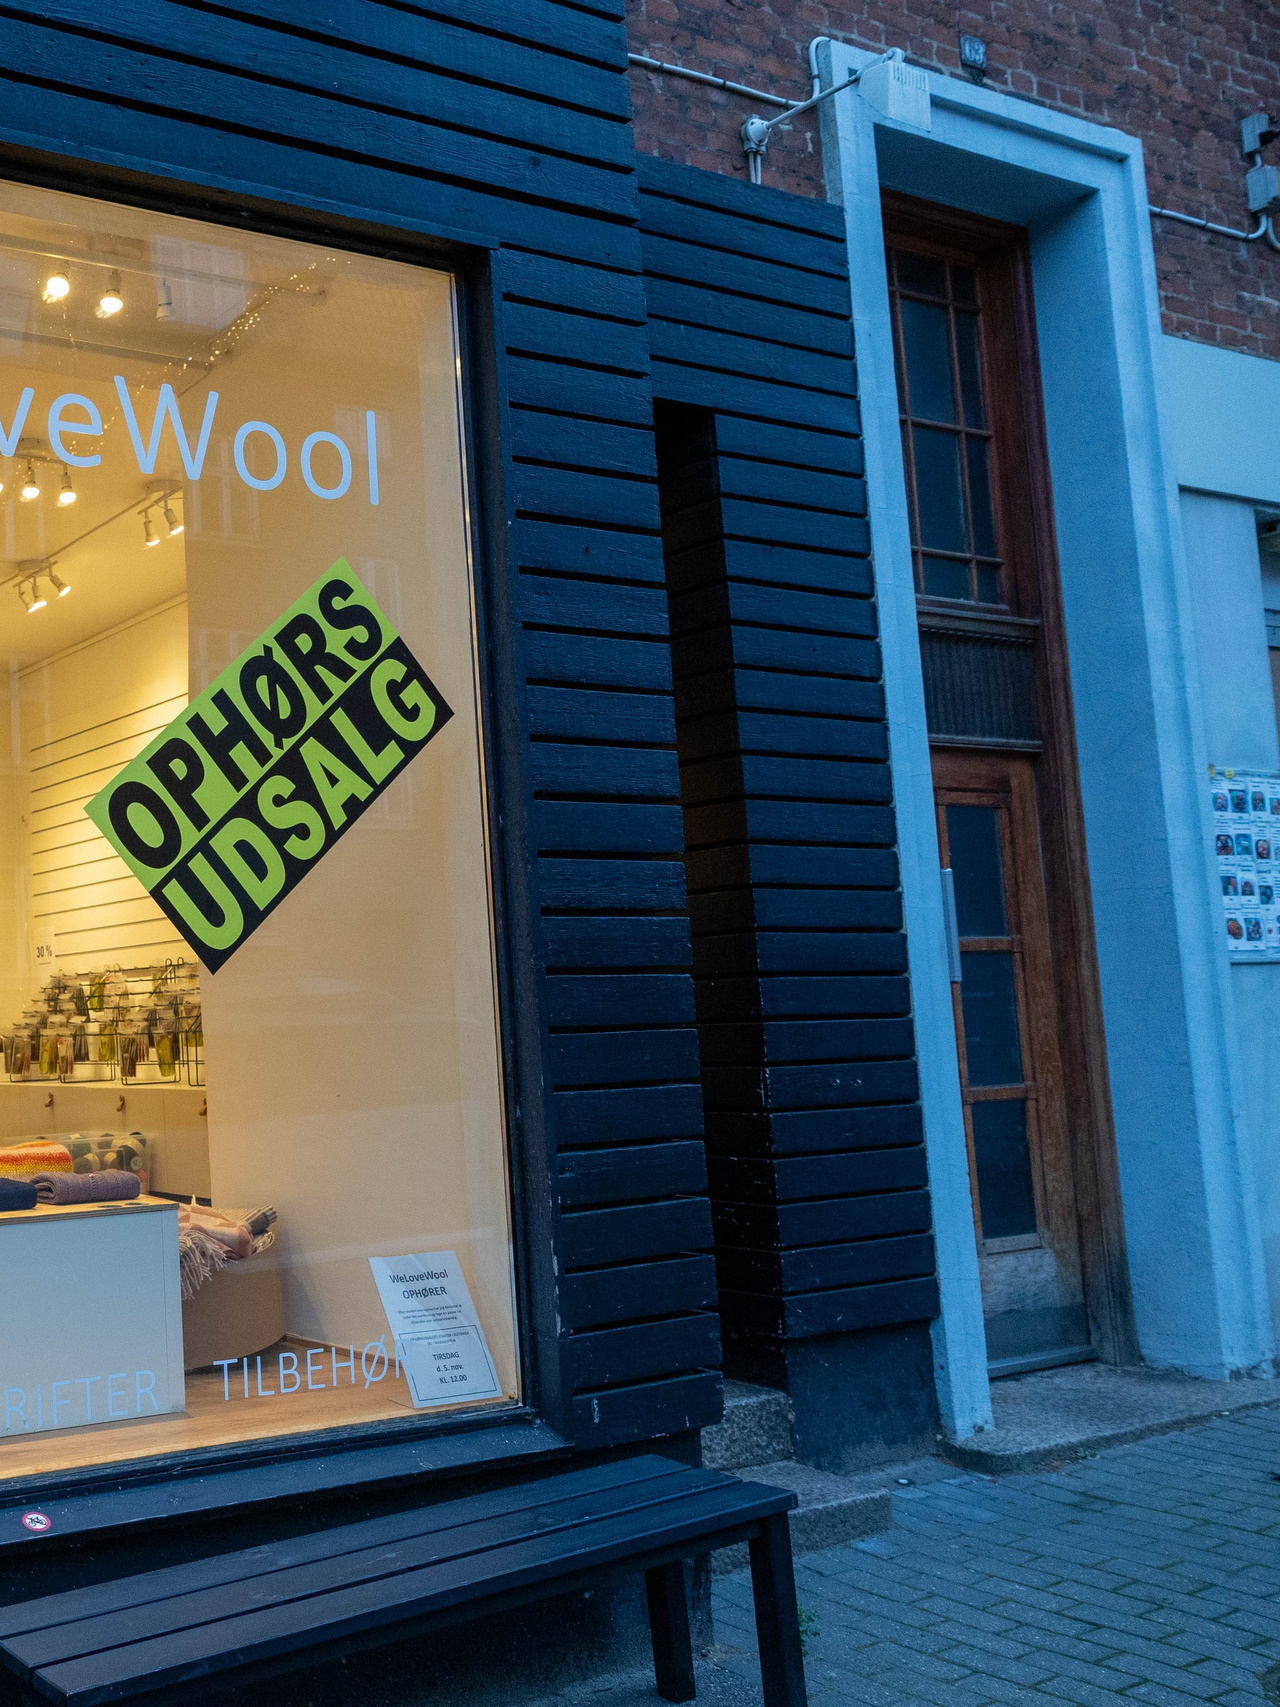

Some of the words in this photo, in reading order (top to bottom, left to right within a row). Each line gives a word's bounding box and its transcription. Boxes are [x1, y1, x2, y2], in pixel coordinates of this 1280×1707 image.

[965, 40, 983, 64] 63
[108, 579, 383, 869] OPHØRS
[161, 658, 436, 950] UDSALG
[36, 945, 45, 958] 30
[45, 944, 53, 958] %
[389, 1269, 449, 1284] WeLoveWool
[402, 1286, 448, 1299] OPHØRER
[433, 1351, 460, 1361] TIRSDAG
[436, 1365, 443, 1373] d.
[443, 1364, 451, 1372] 5.
[439, 1376, 450, 1384] KL.
[450, 1374, 468, 1383] 12.00
